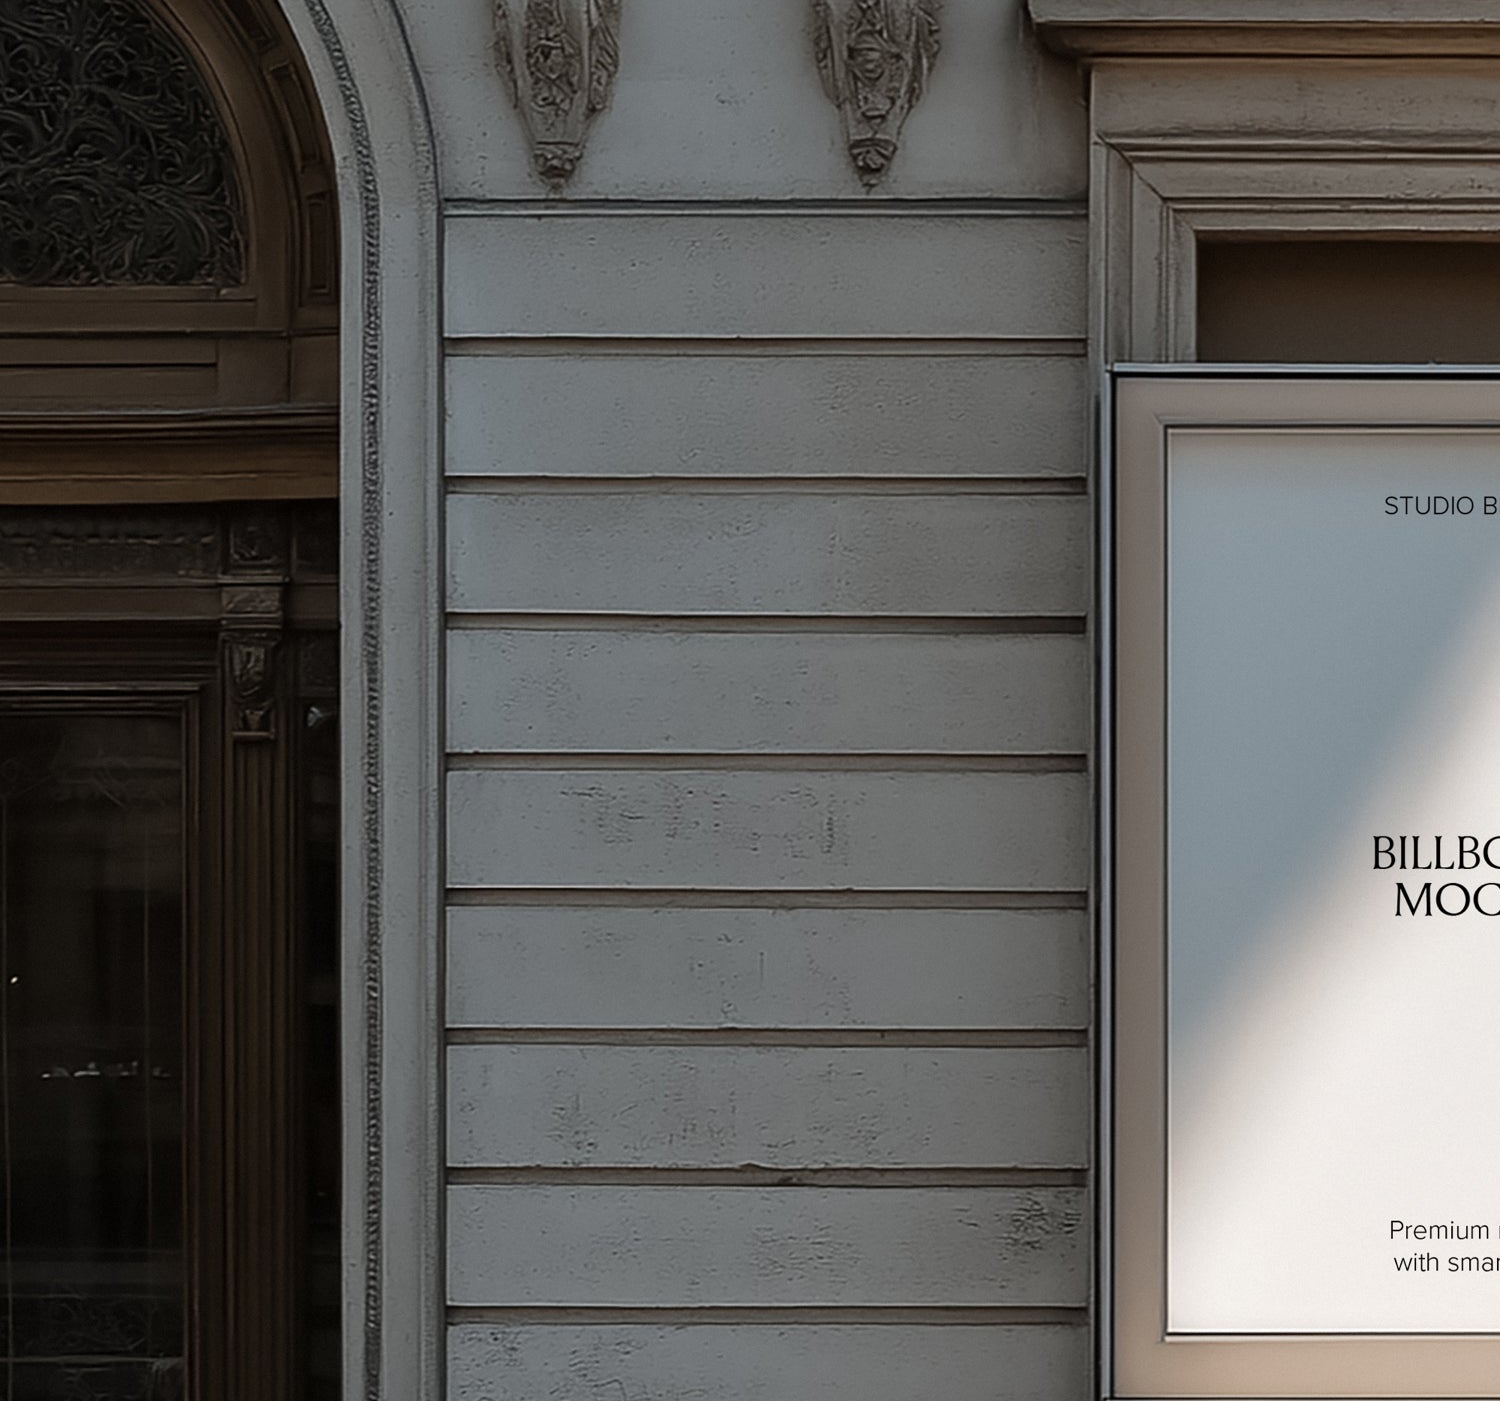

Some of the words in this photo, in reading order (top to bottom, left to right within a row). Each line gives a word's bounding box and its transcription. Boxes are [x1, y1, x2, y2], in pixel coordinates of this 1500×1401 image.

[1384, 495, 1475, 516] STUDIO
[1390, 1220, 1489, 1240] Premium
[1393, 1252, 1439, 1272] with
